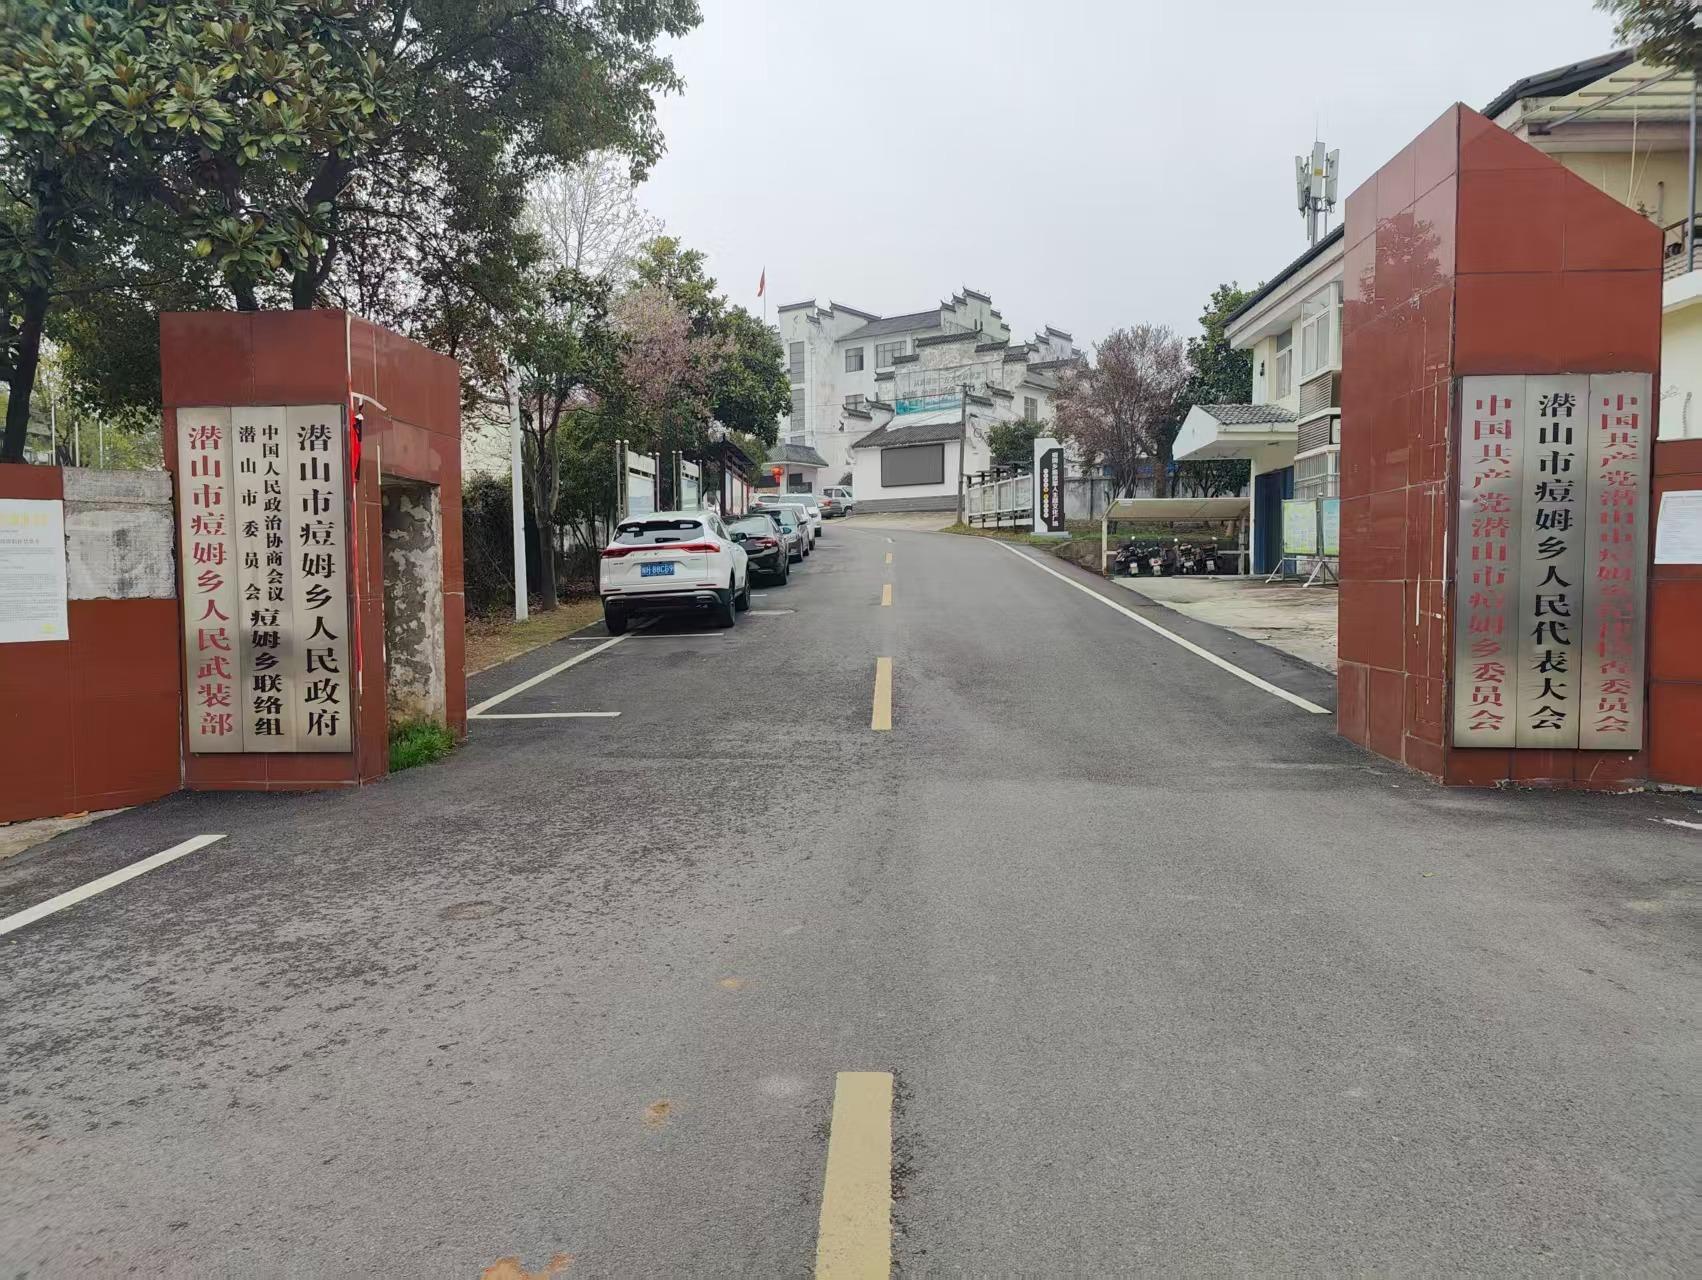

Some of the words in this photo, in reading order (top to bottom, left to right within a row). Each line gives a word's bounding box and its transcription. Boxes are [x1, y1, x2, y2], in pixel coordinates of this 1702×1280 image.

[188, 425, 233, 736] 潜山市痘姆乡人民武装部
[239, 425, 261, 600] 潜山市委员会
[262, 424, 285, 602] 中国人民政治协商会议
[297, 424, 340, 737] 潜山市痘姆乡人民政府
[1467, 394, 1512, 731] 中国共产党潜山市痘姆乡委员会
[1528, 392, 1576, 730] 潜山市痘姆乡人民代表大会
[249, 607, 284, 736] 痘姆乡联络组
